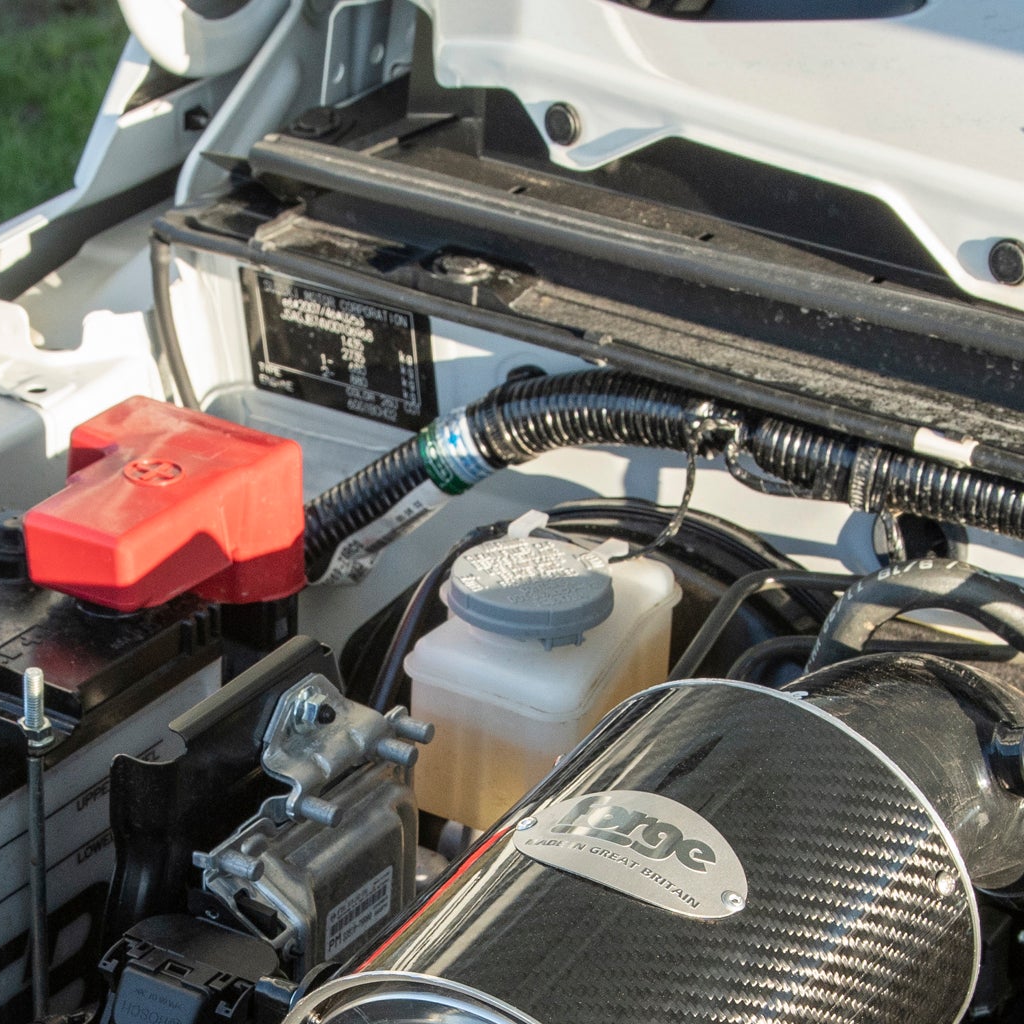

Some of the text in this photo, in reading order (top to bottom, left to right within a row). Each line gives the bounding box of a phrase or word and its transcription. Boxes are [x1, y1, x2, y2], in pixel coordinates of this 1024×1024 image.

[303, 289, 336, 308] MOTOR
[339, 300, 409, 328] CORPORATION
[76, 779, 110, 813] UPPE
[589, 846, 641, 869] GREAT
[640, 867, 701, 910] BRITAIN
